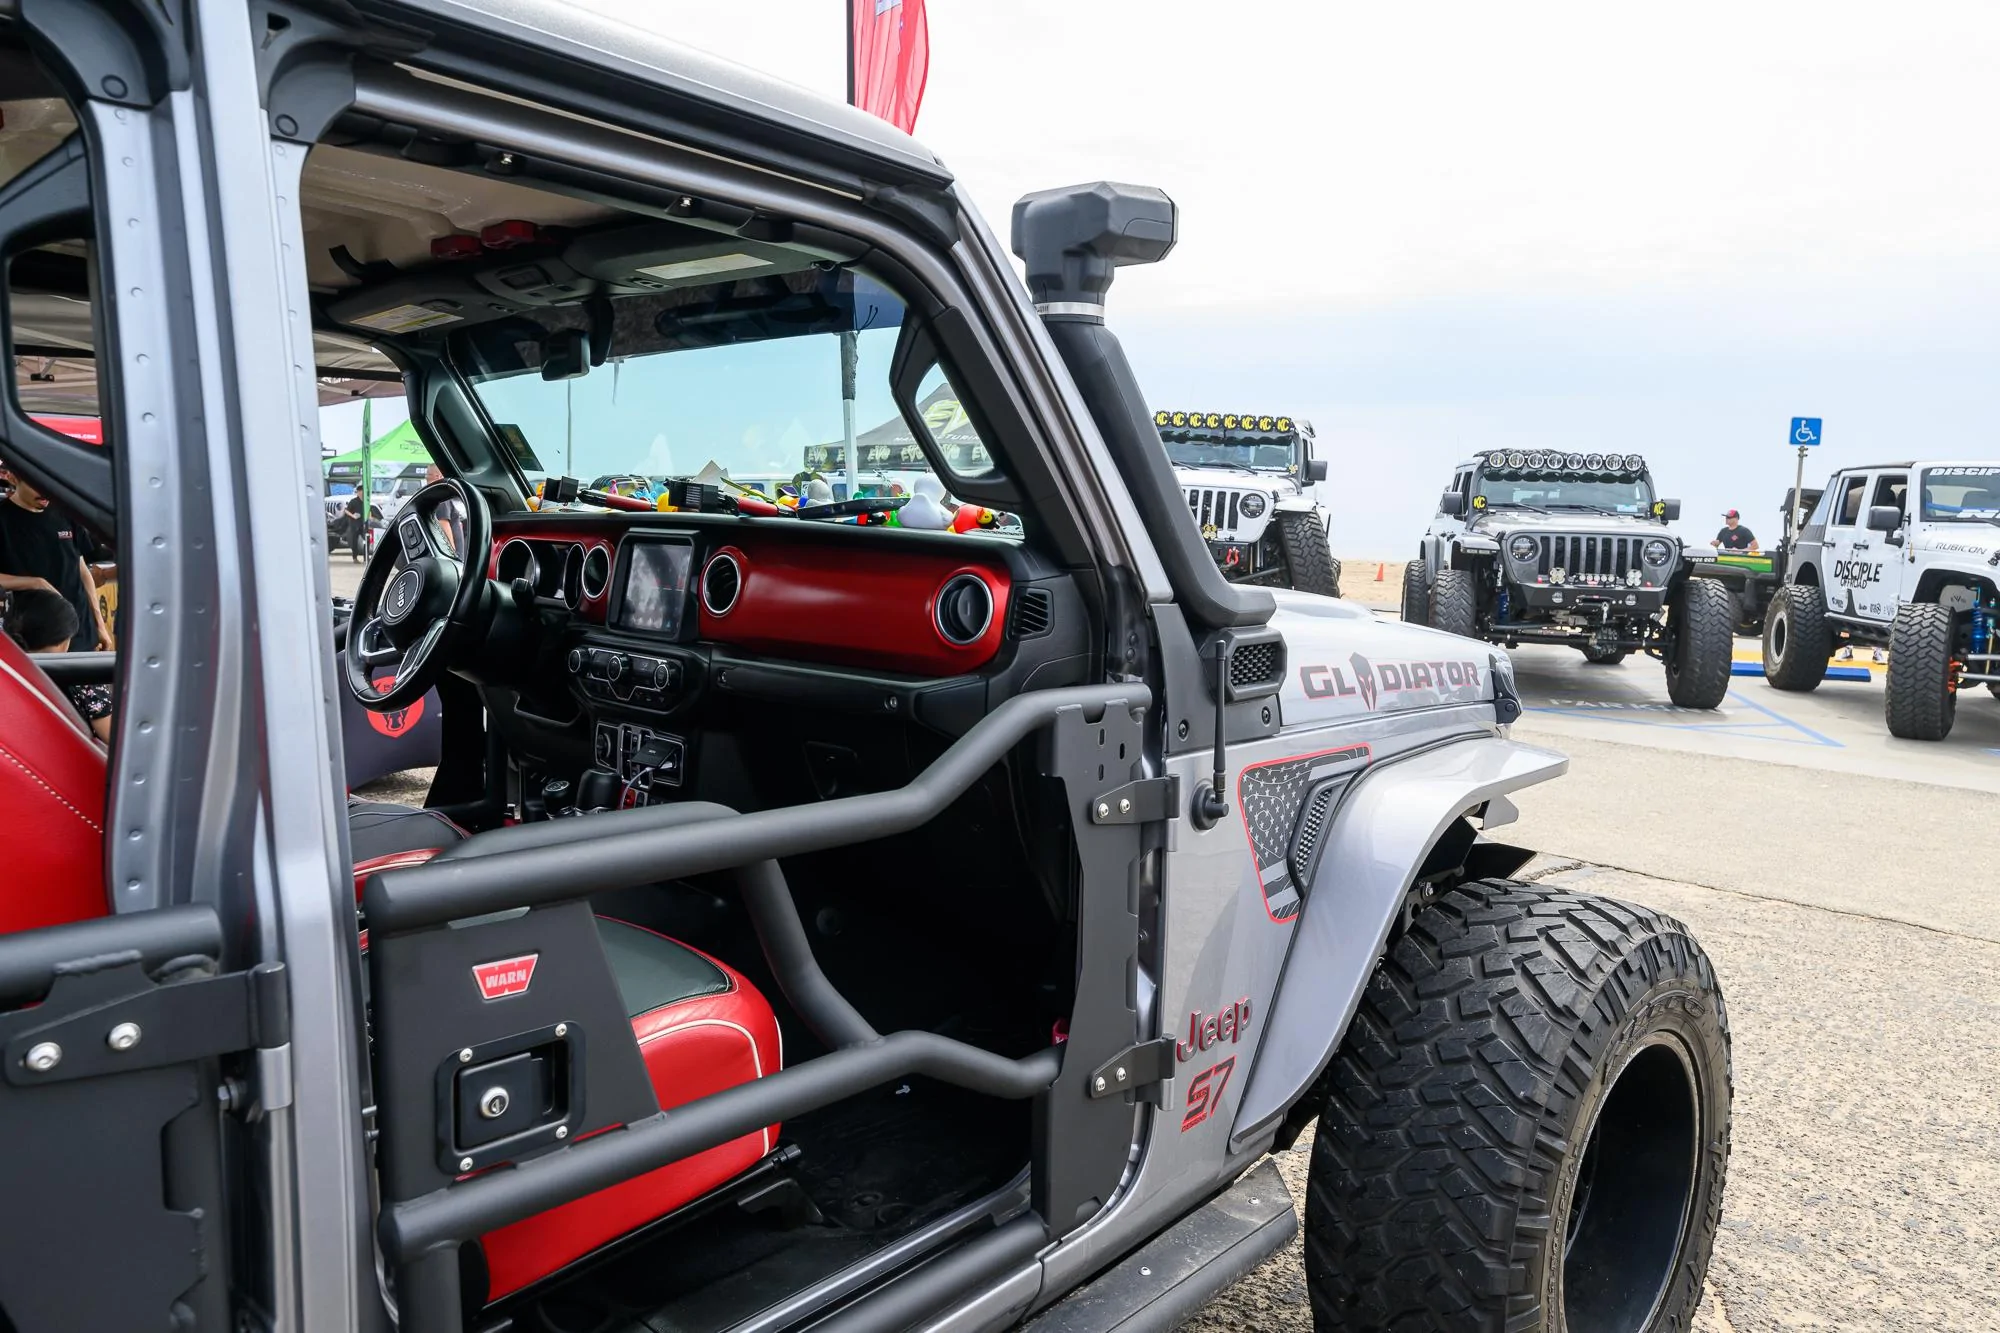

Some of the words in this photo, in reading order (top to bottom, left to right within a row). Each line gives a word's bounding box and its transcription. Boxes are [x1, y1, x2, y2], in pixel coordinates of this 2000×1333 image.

[1156, 412, 1169, 426] KC
[1173, 413, 1185, 427] KC
[1189, 413, 1202, 427] KC
[1206, 414, 1219, 428] KC
[1224, 415, 1236, 429] KC
[1241, 416, 1254, 430] KC
[1259, 417, 1272, 431] KC
[1277, 418, 1290, 432] KC
[1473, 496, 1486, 509] KC
[1653, 502, 1665, 515] KC
[1935, 542, 1988, 555] RUBICON
[1834, 560, 1883, 582] DISCIPLE
[397, 580, 407, 608] Jeep
[485, 969, 527, 989] WARN
[1176, 996, 1253, 1063] Jeep
